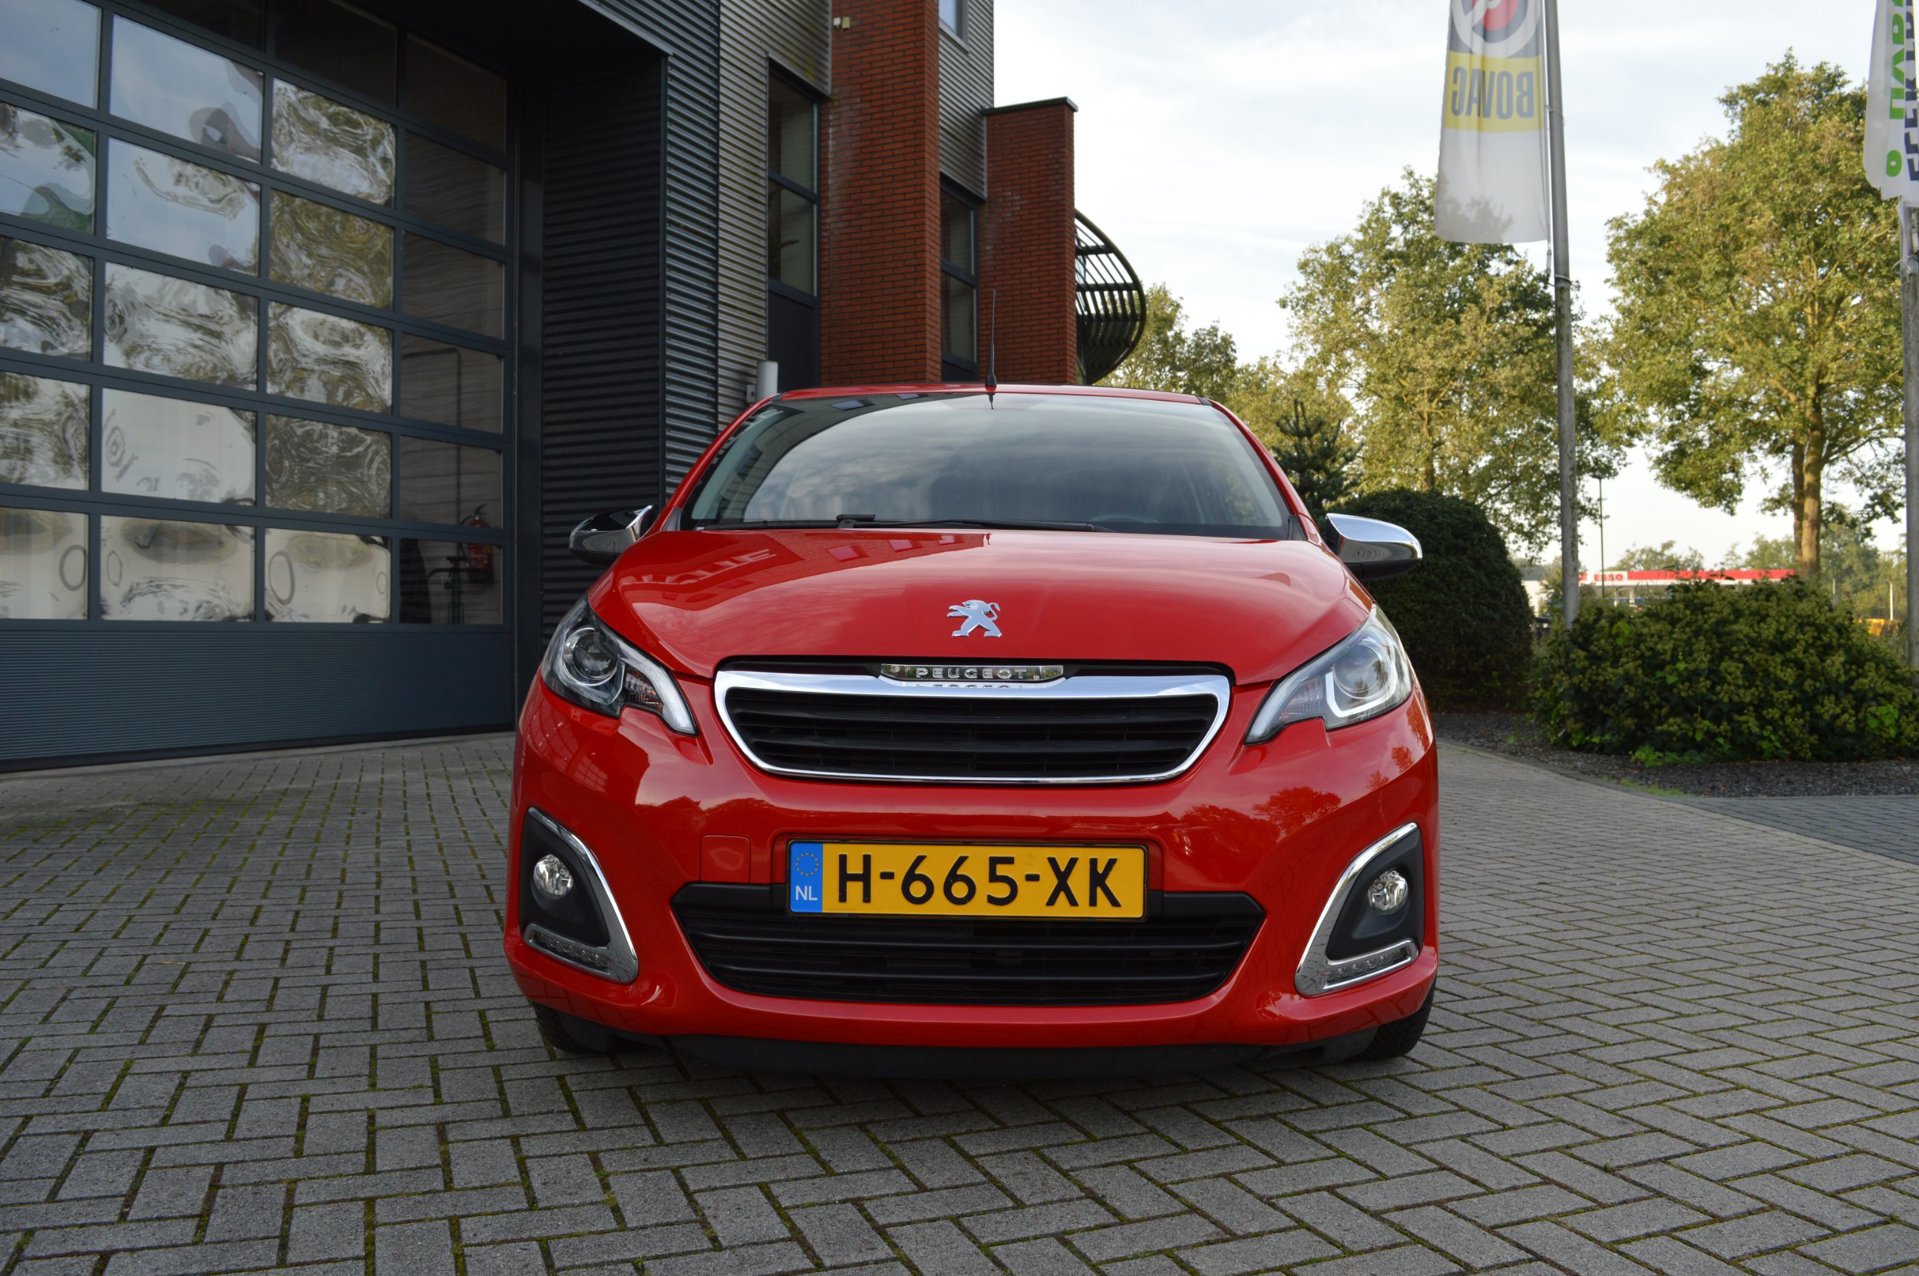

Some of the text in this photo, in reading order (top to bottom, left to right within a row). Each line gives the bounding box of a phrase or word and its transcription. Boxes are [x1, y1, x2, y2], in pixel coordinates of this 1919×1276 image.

[916, 667, 1027, 679] PEUGEOT
[838, 854, 1122, 907] H-665-XK
[795, 885, 818, 901] NL
